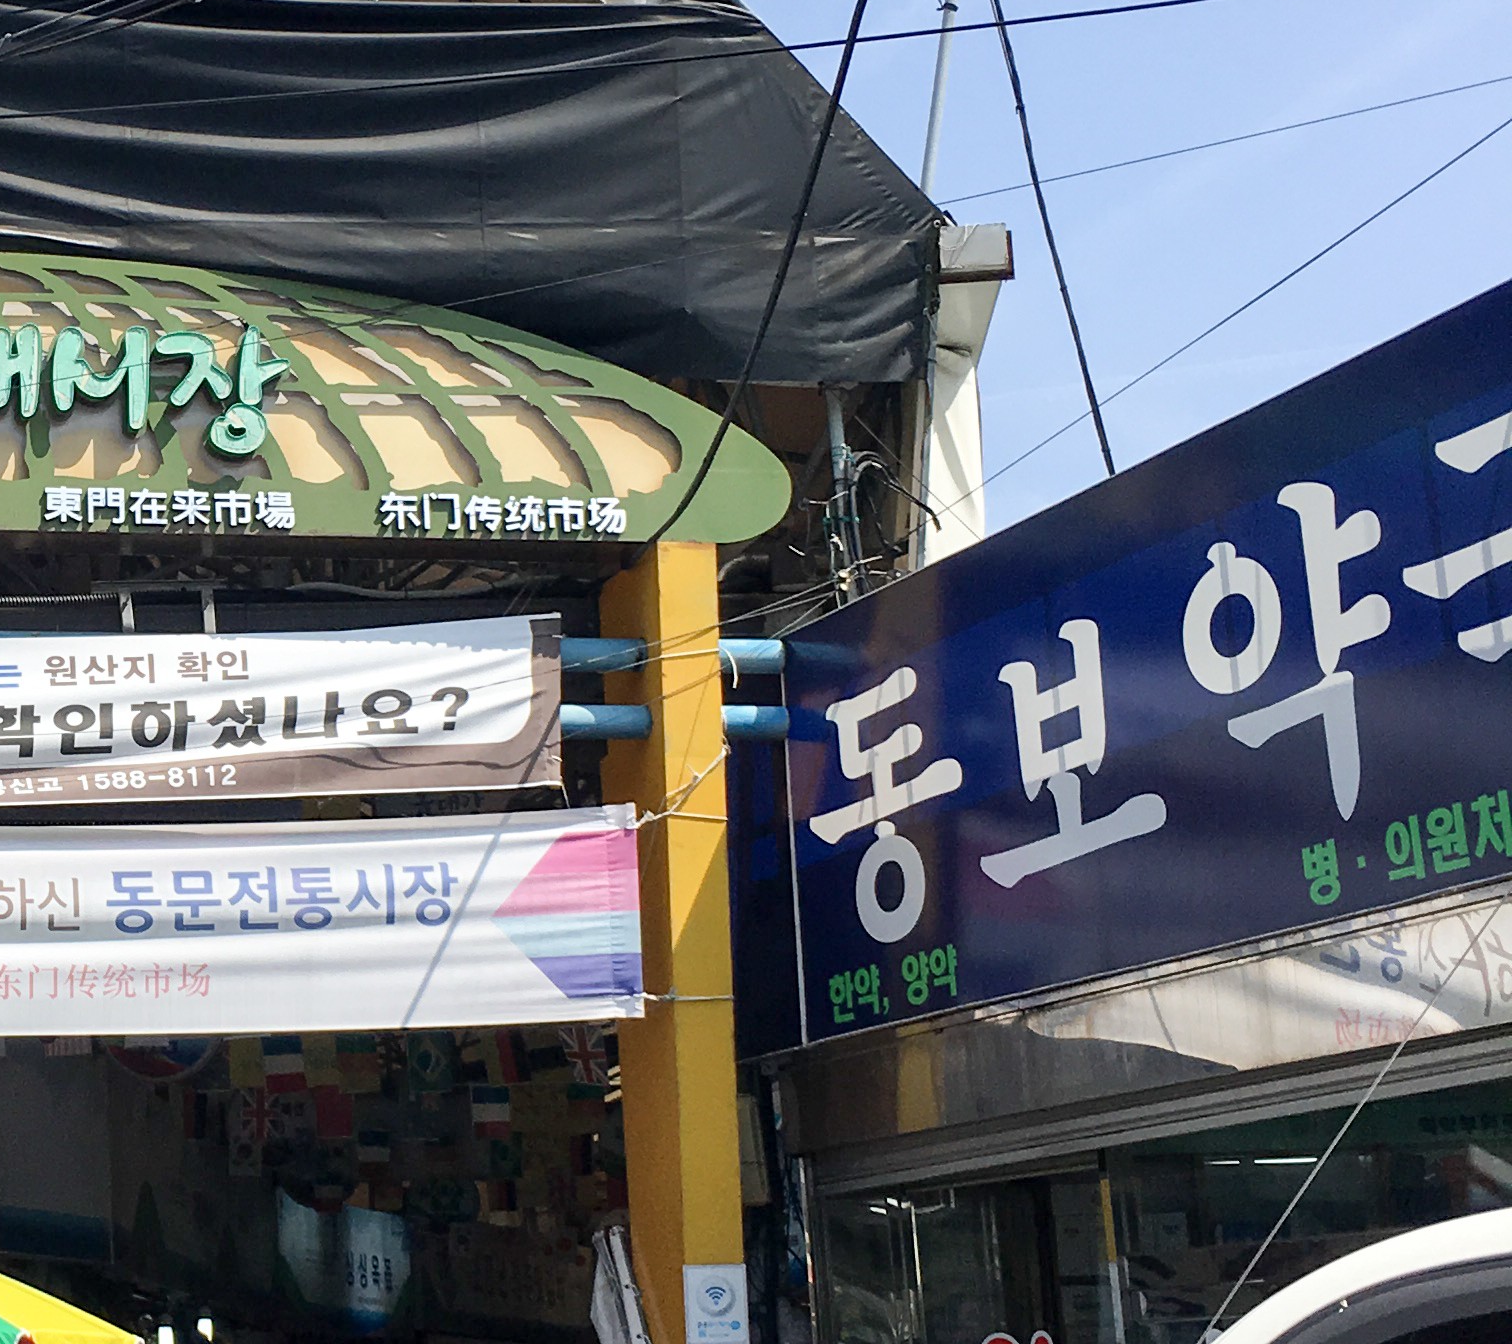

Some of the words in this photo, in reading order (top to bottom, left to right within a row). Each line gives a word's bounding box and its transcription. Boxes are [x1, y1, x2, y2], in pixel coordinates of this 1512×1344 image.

[44, 485, 296, 530] 東門在来市場
[380, 490, 628, 534] 东门传统市场
[44, 653, 156, 686] 원산지
[177, 648, 251, 684] 확인
[77, 764, 238, 791] 1588-8112
[106, 860, 459, 933] 동문전통시장
[829, 970, 889, 1024] 한약,
[901, 943, 959, 1007] 양약
